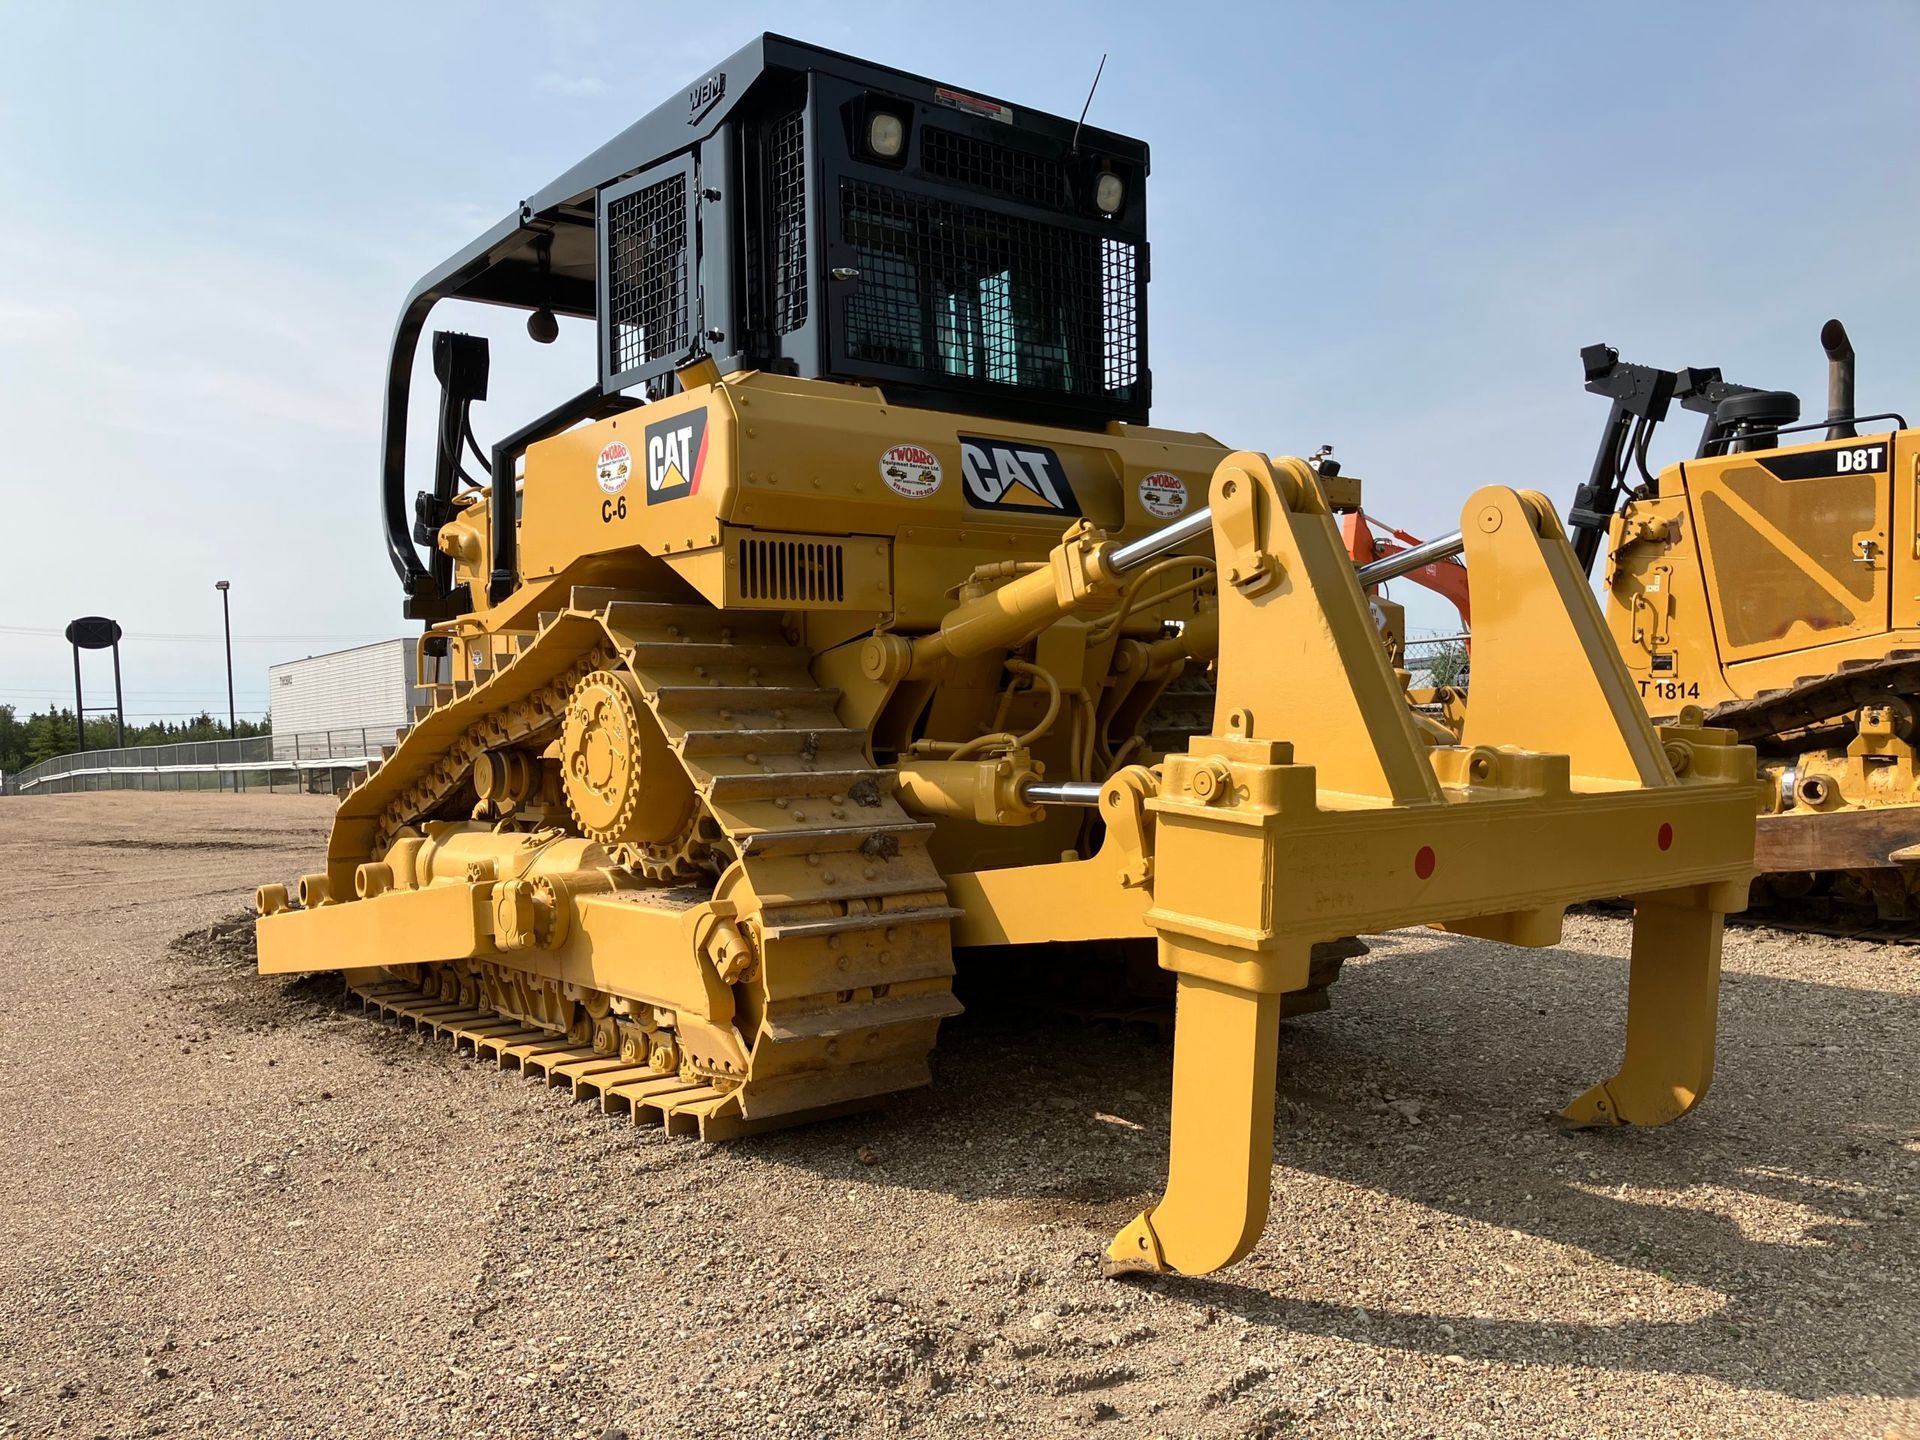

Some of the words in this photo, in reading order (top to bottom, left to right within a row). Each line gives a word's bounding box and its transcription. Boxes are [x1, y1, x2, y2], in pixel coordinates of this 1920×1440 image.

[649, 425, 693, 491] CAT
[888, 447, 935, 466] TWOBRO
[1836, 447, 1883, 473] D8T
[960, 443, 1065, 509] CAT
[1147, 474, 1181, 489] TWOBRO
[602, 496, 627, 523] C-6
[1638, 680, 1651, 697] T
[1655, 682, 1700, 700] 1814
